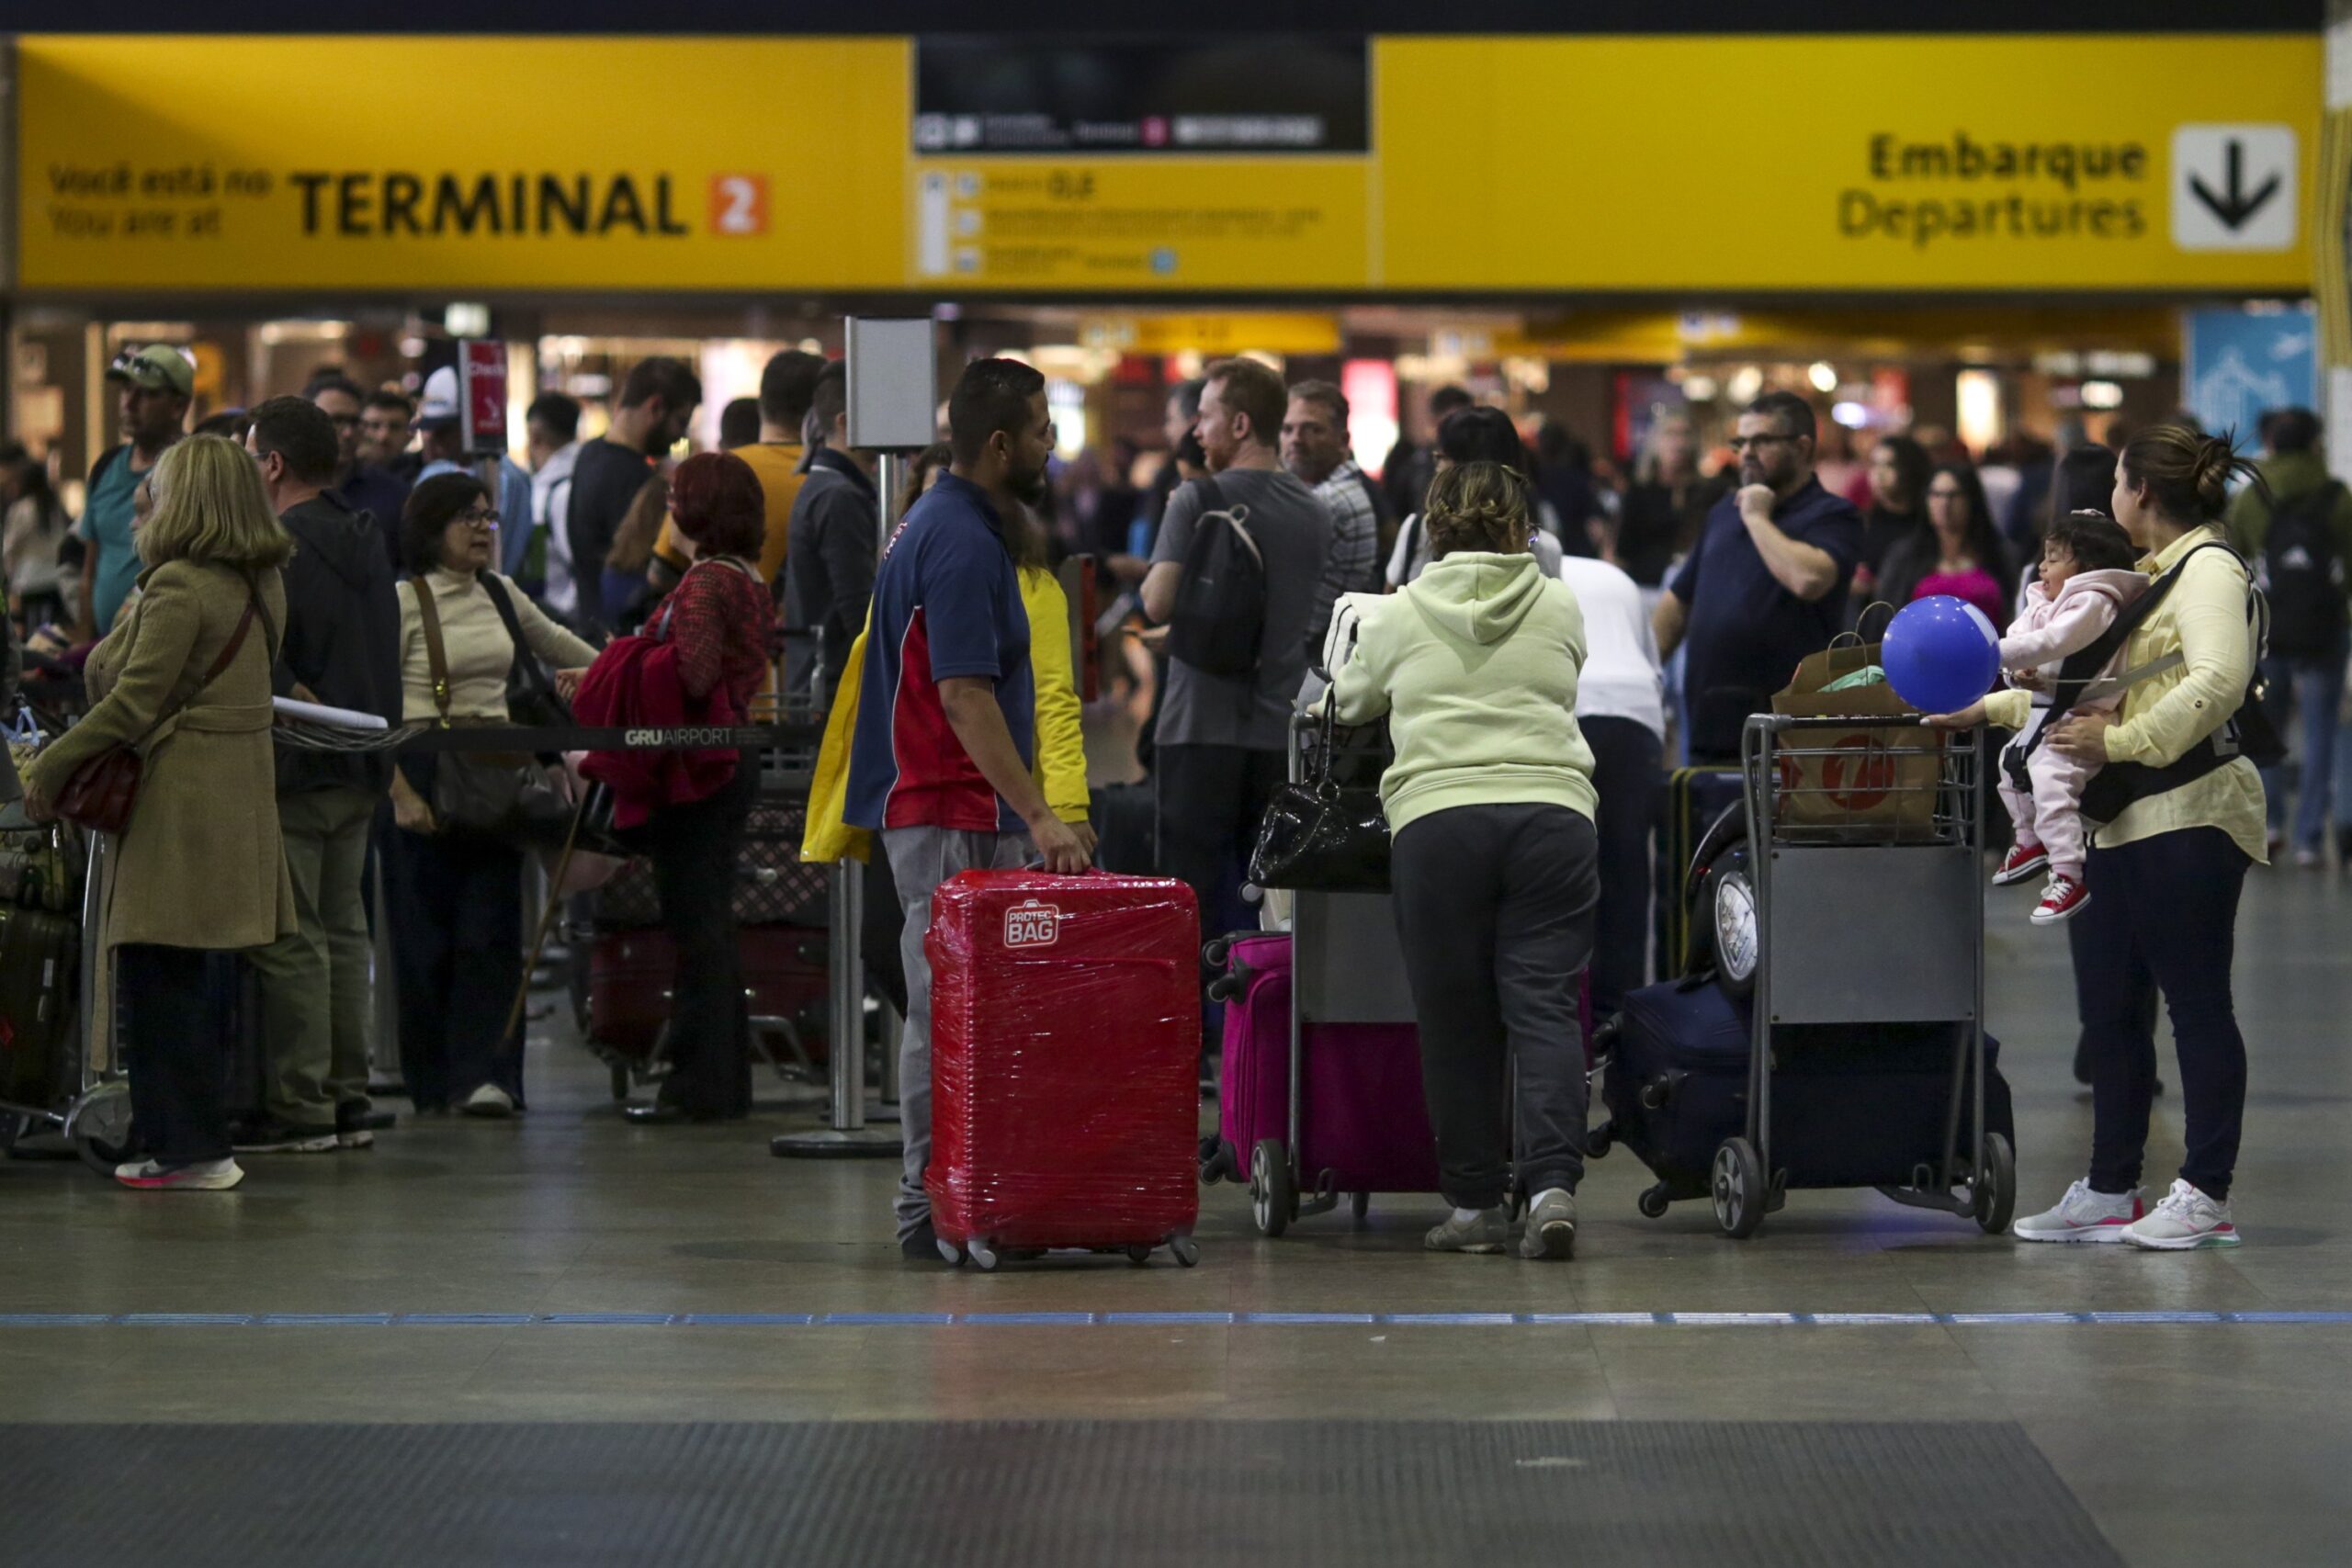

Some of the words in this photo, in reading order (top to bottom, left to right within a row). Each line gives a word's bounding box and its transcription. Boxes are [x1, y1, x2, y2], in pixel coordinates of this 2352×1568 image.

[1870, 132, 2147, 188] Embarque
[290, 173, 687, 237] TERMINAL
[721, 178, 754, 231] 2
[1839, 190, 2147, 247] Departures
[1008, 920, 1053, 943] BAG
